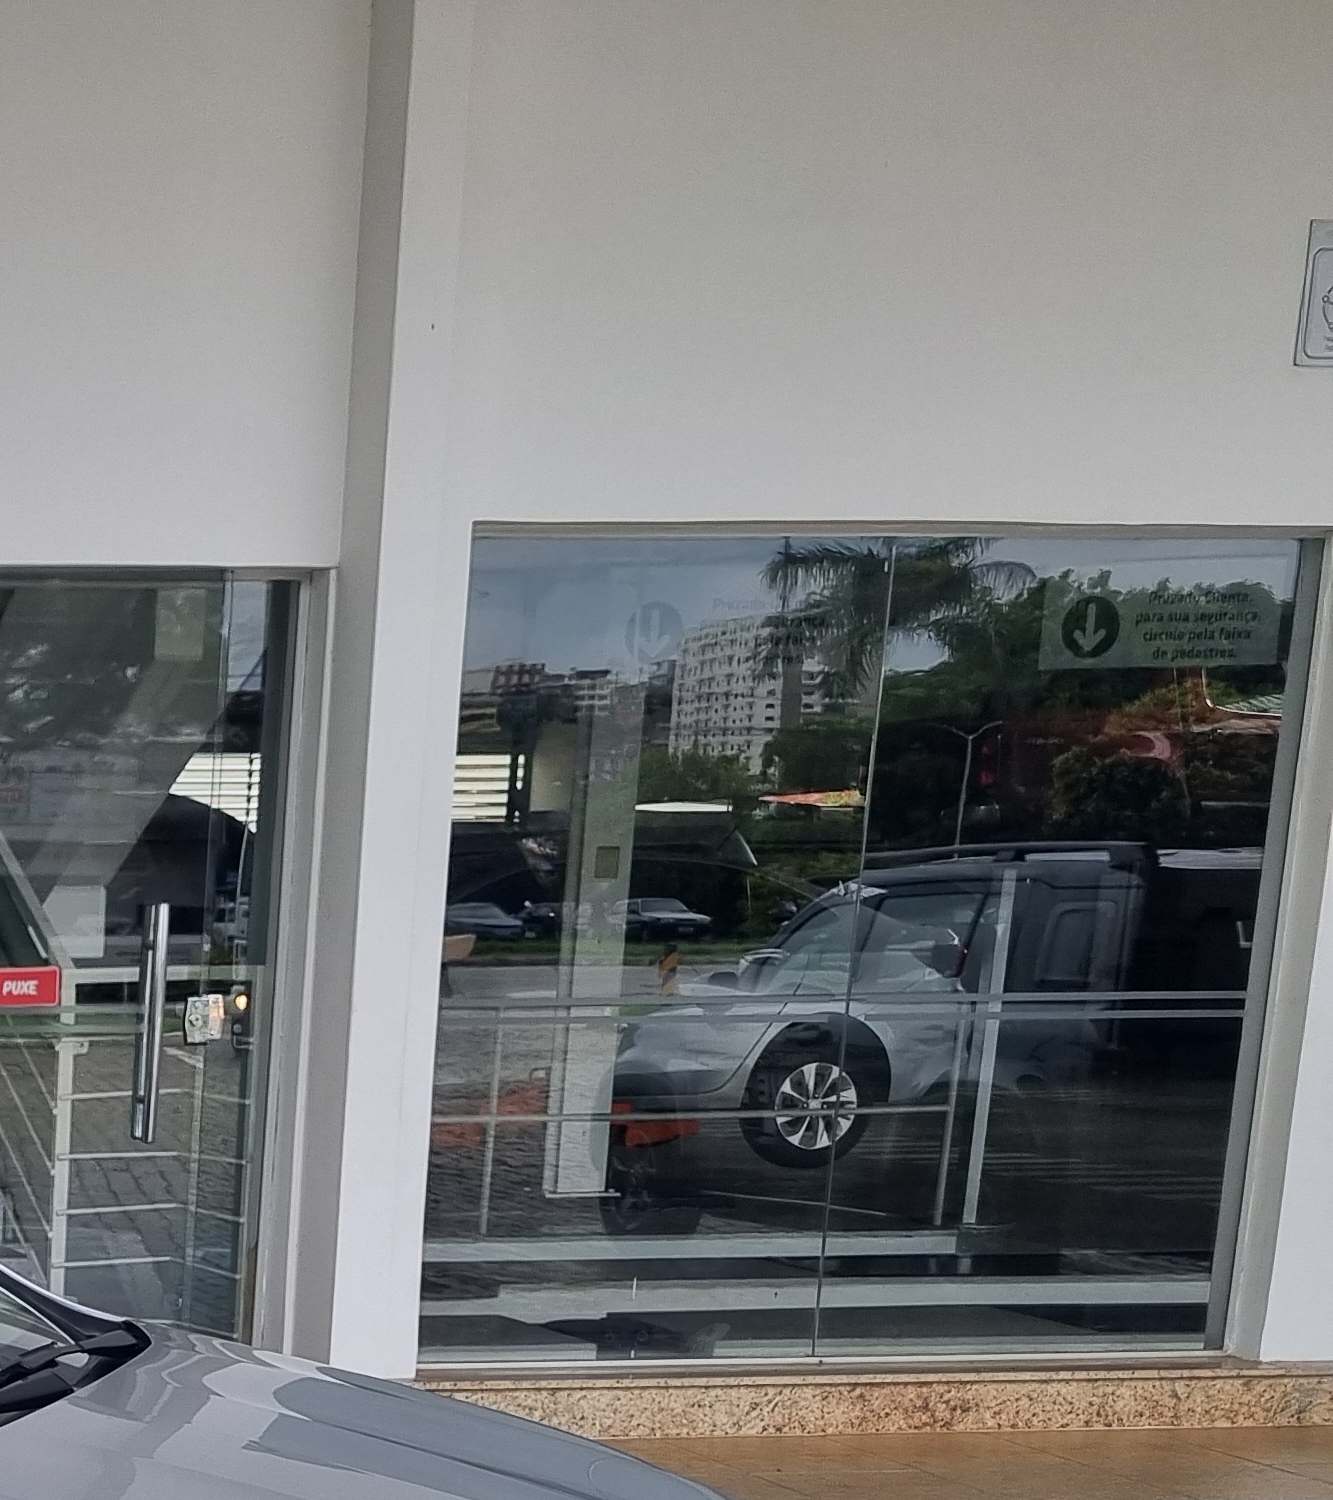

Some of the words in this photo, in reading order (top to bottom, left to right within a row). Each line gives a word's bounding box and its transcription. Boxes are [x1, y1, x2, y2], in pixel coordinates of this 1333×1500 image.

[1135, 611, 1164, 628] para
[1168, 611, 1190, 623] sua
[1187, 627, 1215, 643] pela
[1219, 626, 1252, 641] faixa
[1152, 646, 1169, 660] de
[2, 979, 39, 997] PUXE
